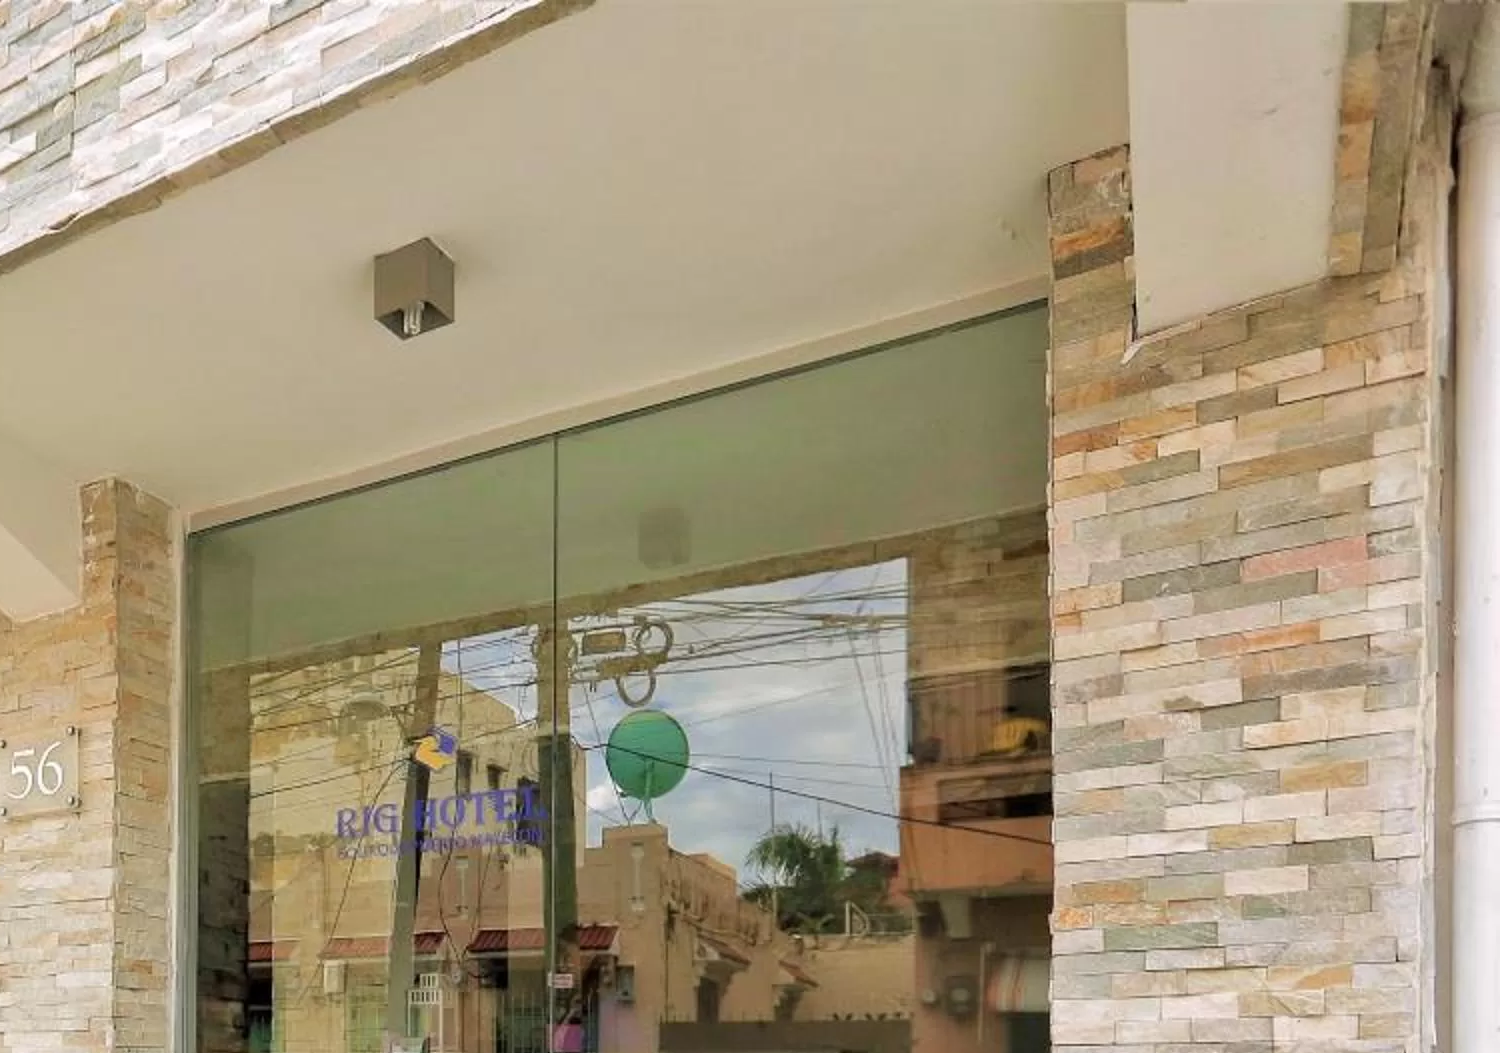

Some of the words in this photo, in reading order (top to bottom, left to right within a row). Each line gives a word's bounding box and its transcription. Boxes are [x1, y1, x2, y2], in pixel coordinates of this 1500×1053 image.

[6, 740, 64, 800] 56
[336, 803, 399, 838] RIG
[414, 784, 547, 832] HOTEL
